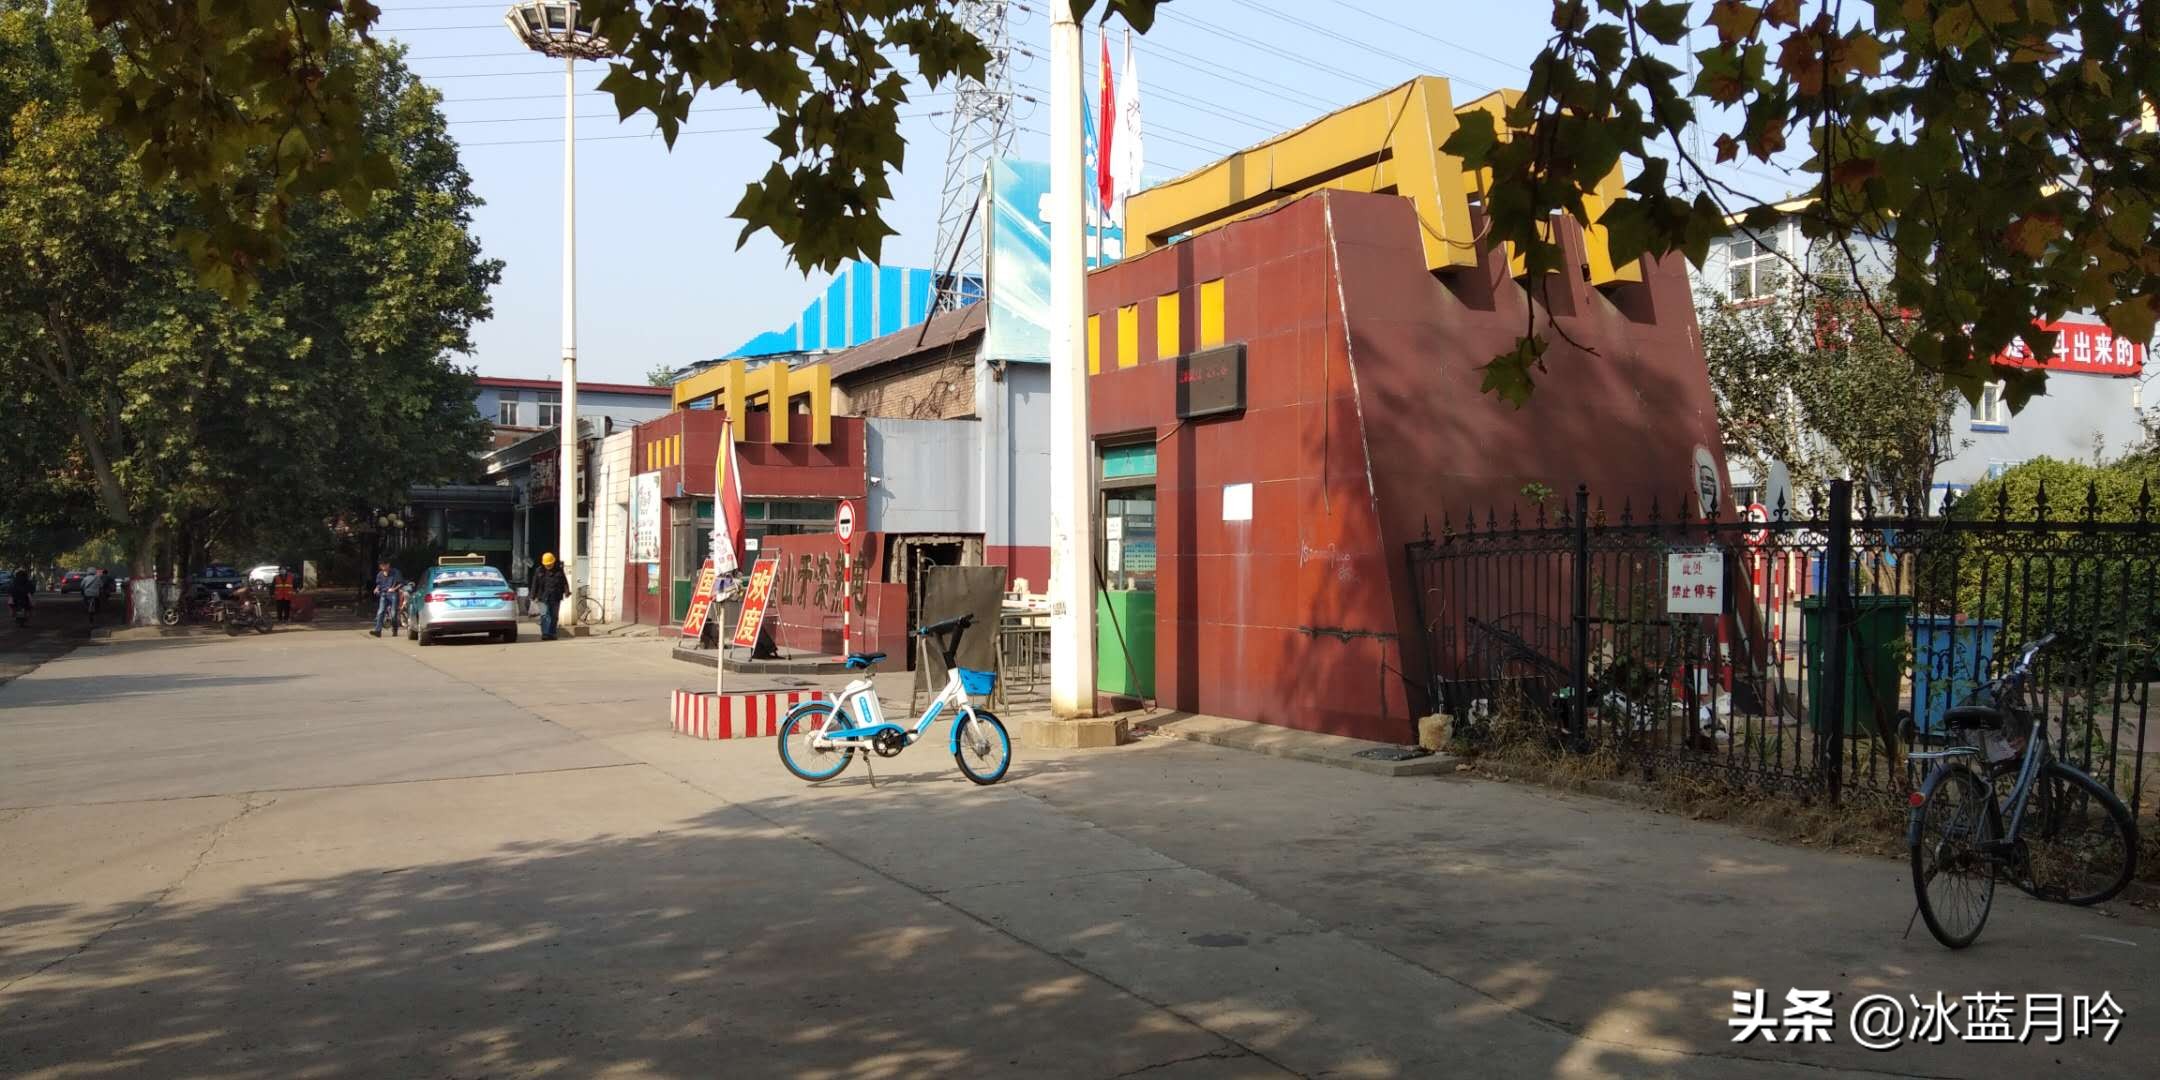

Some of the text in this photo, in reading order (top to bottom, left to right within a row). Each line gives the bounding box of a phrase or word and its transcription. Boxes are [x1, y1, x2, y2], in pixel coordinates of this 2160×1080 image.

[2004, 329, 2134, 367] 是斗出来的
[1682, 560, 1703, 576] 此处
[686, 567, 716, 632] 国庆
[737, 569, 772, 642] 欢度
